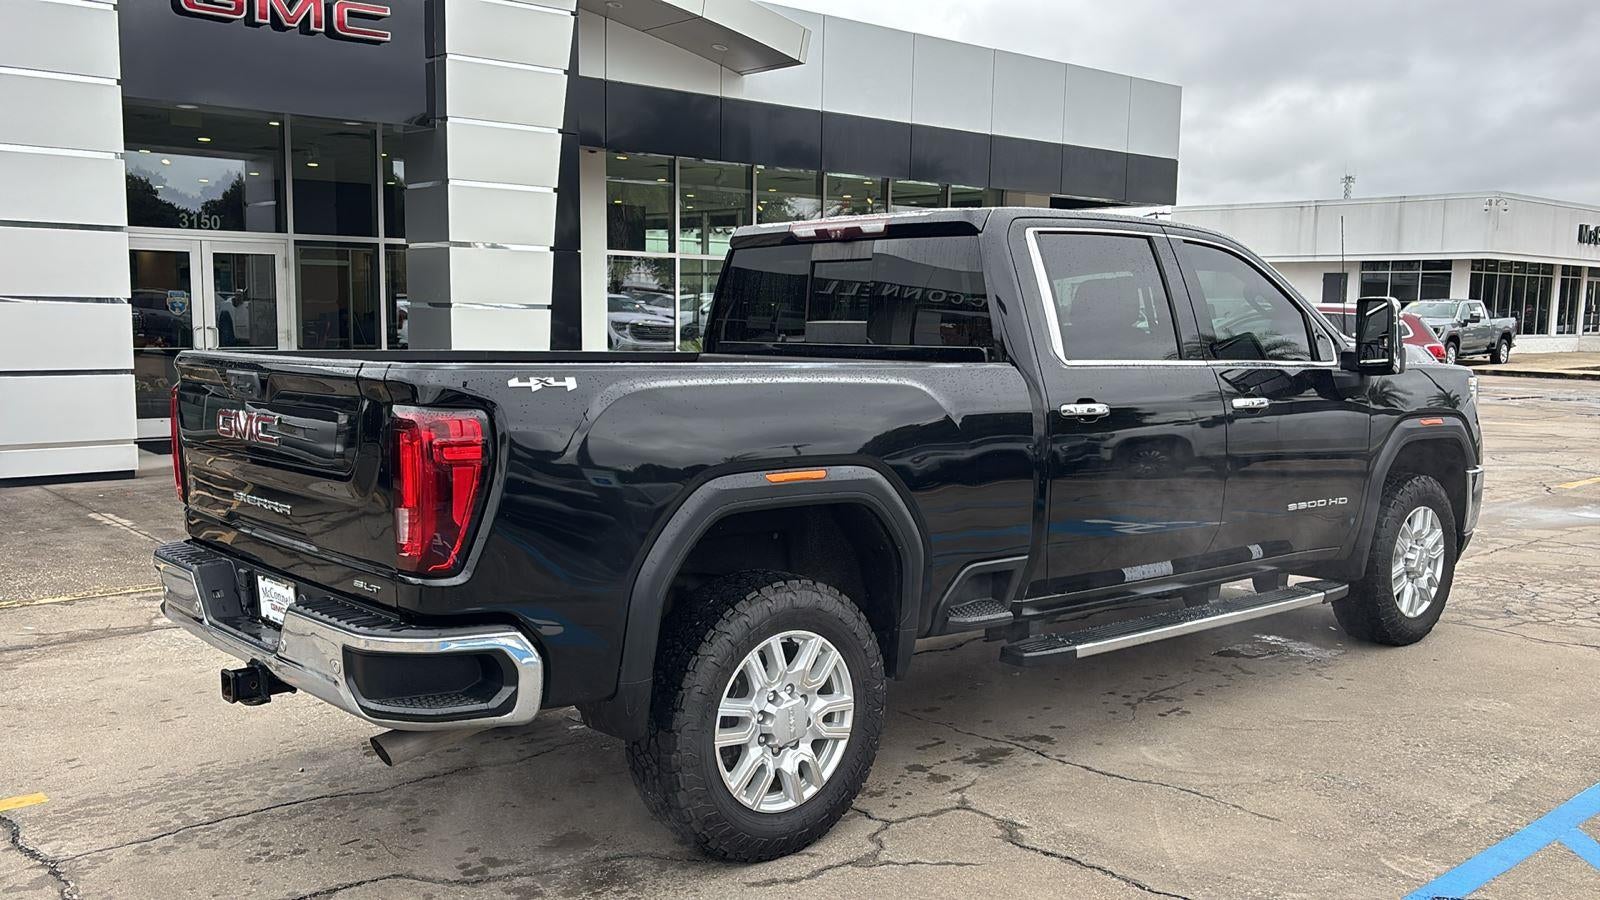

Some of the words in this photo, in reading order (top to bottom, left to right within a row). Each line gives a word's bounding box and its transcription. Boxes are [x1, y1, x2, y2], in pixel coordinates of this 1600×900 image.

[179, 212, 221, 230] 3150
[217, 408, 281, 446] GMC
[233, 491, 292, 515] SIERRA
[1328, 496, 1348, 506] HD
[353, 579, 381, 592] SLT
